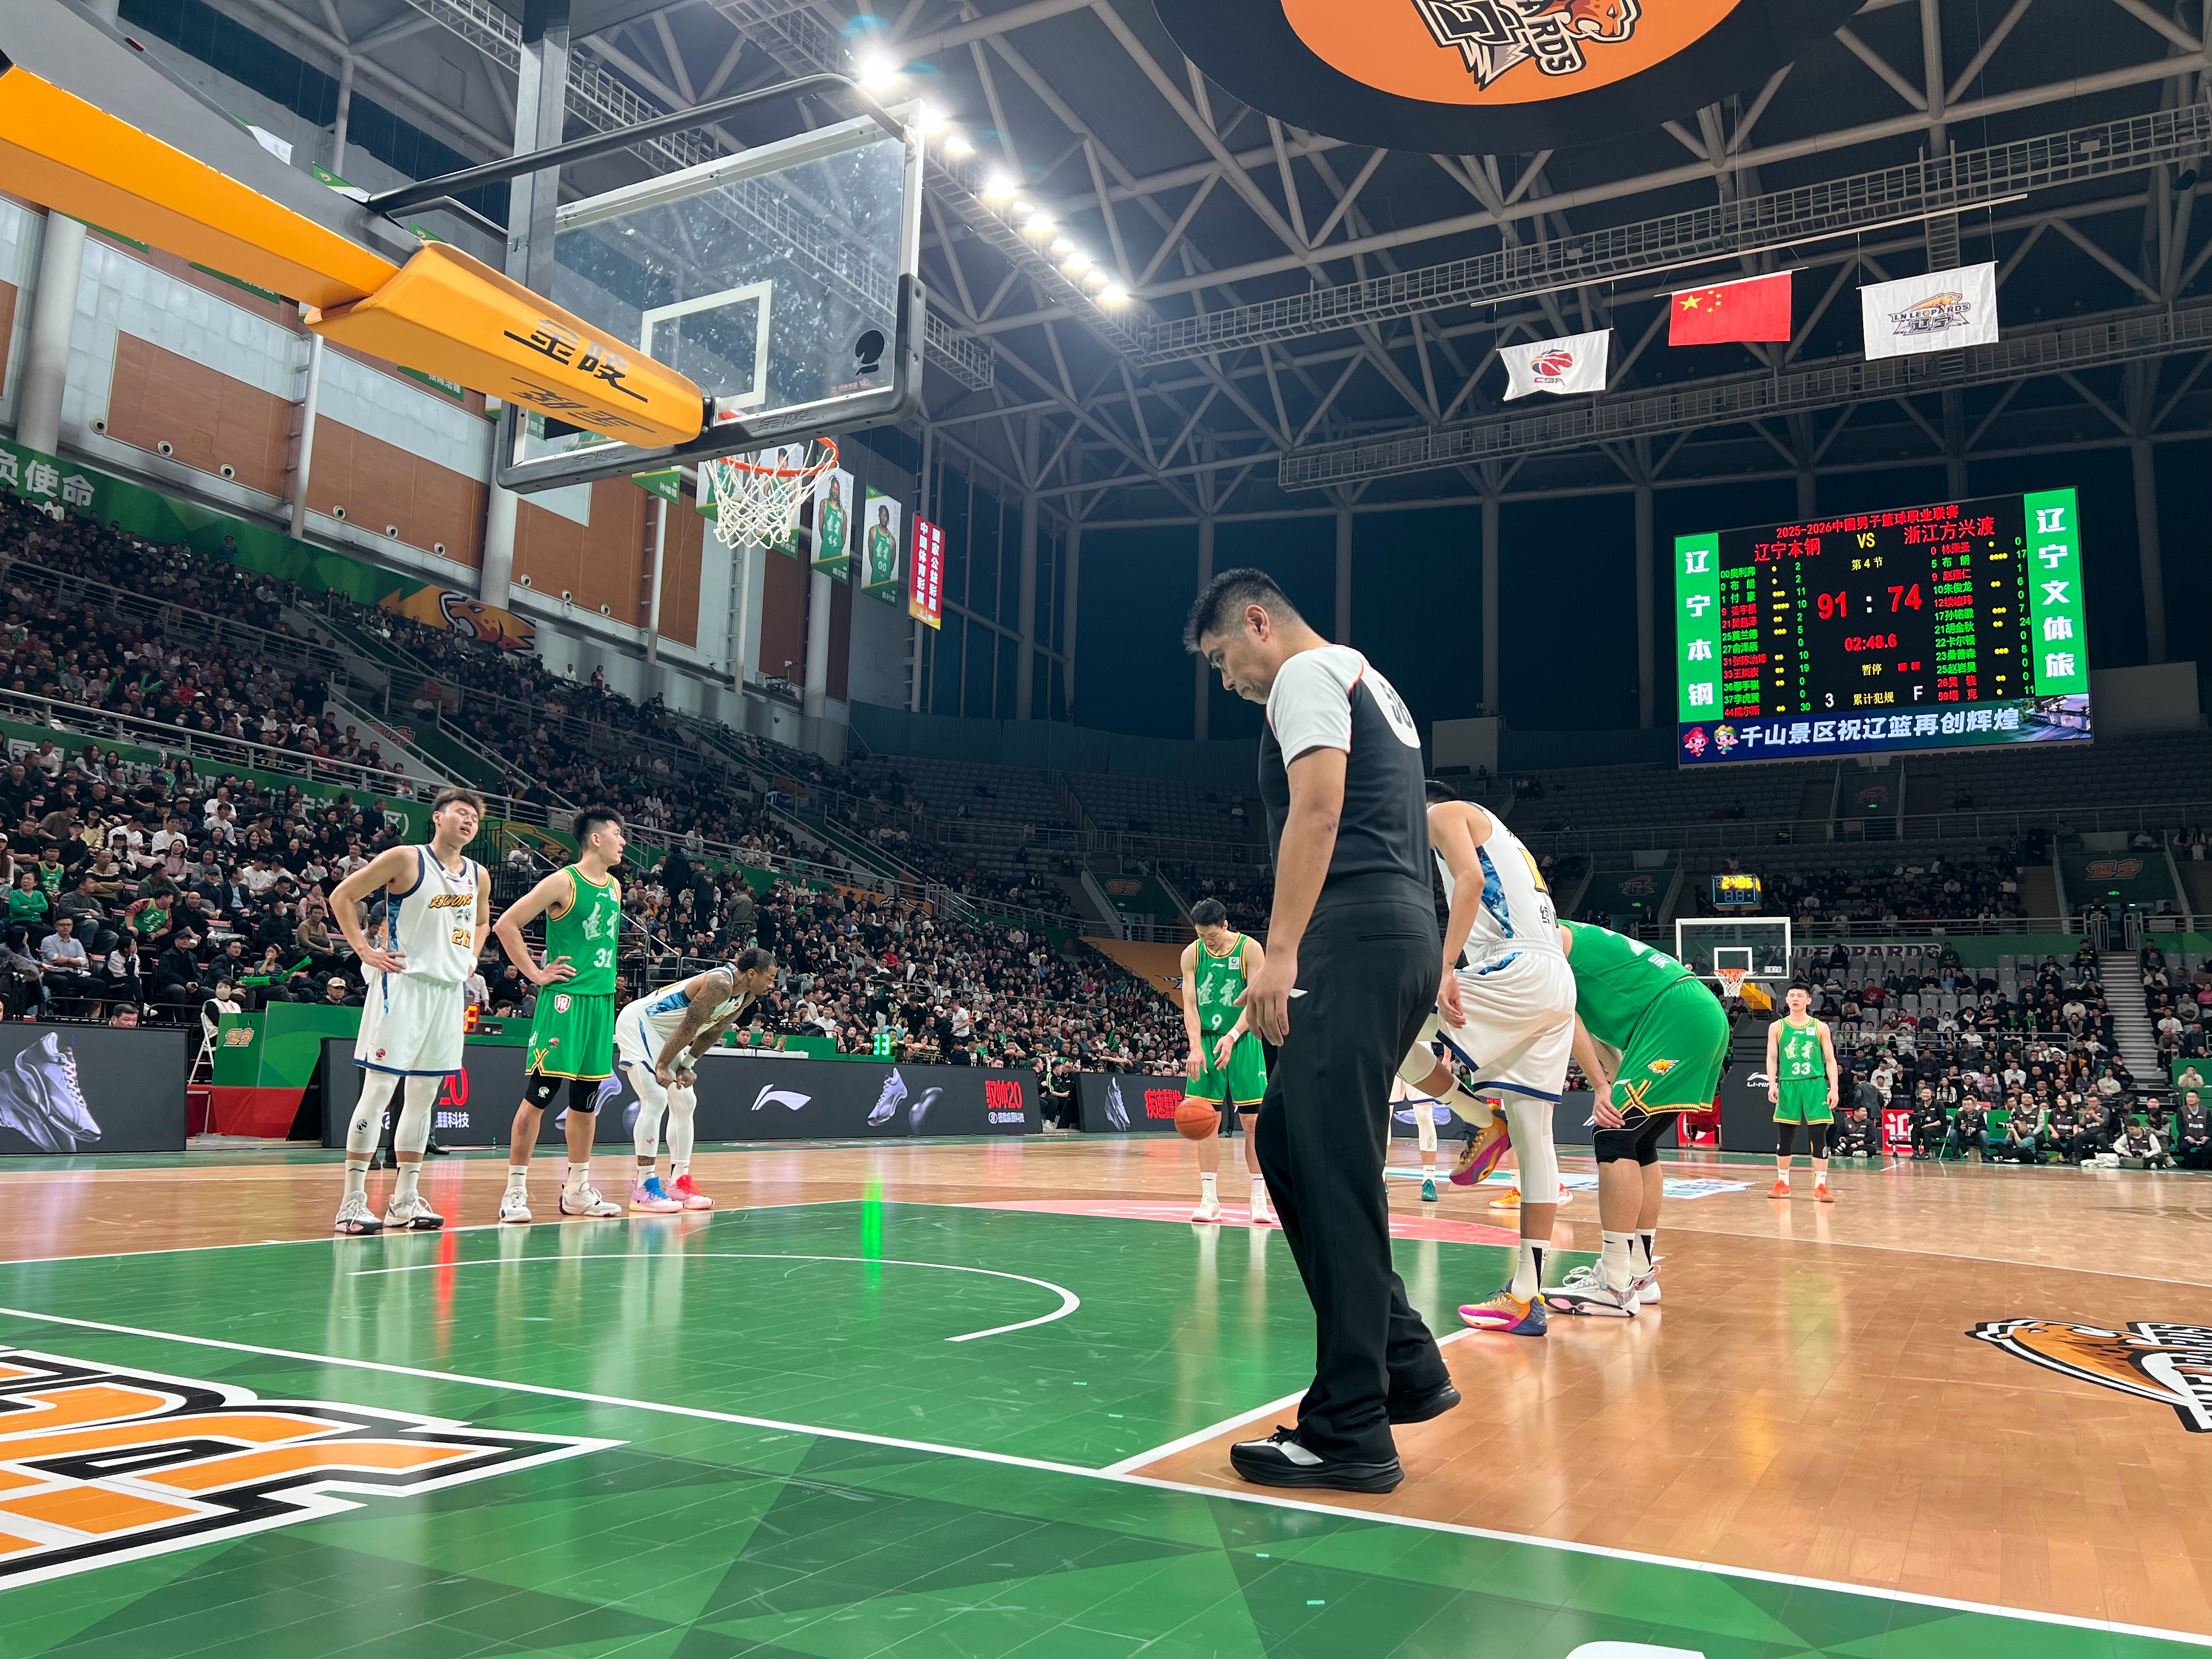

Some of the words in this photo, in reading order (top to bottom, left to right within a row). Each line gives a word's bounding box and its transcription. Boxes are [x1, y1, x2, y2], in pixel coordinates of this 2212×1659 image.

[504, 319, 648, 403] 金陵
[1534, 377, 1566, 386] CBA
[1776, 505, 1959, 539] 2025-2026中国男子篮球职业联赛
[1754, 538, 1821, 562] 辽宁本钢
[1857, 532, 1876, 549] VS
[1904, 516, 1995, 545] 浙江方兴渡
[1931, 546, 1937, 555] 0
[2015, 537, 2021, 545] 0
[916, 521, 928, 606] 中国体育彩票
[1931, 559, 1937, 568] 5
[2017, 549, 2027, 558] 17
[928, 527, 941, 612] 国家公益彩票
[1796, 562, 1801, 571] 2
[1932, 572, 1938, 582] 9
[2017, 564, 2022, 572] 1
[1720, 583, 1726, 591] 0
[1796, 575, 1801, 583] 2
[2017, 578, 2023, 586] 6
[1797, 588, 1805, 596] 11
[2018, 591, 2024, 599] 0
[2036, 507, 2075, 677] 辽宁文体旅
[1797, 600, 1807, 608] 10
[1817, 591, 1847, 619] 91
[1888, 584, 1922, 612] 74
[2019, 604, 2024, 612] 7
[1797, 613, 1803, 622] 2
[2019, 617, 2030, 626] 24
[1685, 550, 1714, 706] 辽宁本钢
[1798, 625, 1803, 634] 5
[2020, 631, 2027, 640] 0
[1798, 639, 1804, 647] 0
[1844, 633, 1897, 652] 02:48.6
[2021, 645, 2028, 653] 8
[1799, 651, 1809, 659] 10
[1800, 664, 1809, 673] 19
[2022, 658, 2028, 667] 0
[1861, 663, 1882, 676] 暂停
[2023, 672, 2029, 680] 0
[1800, 677, 1805, 685] 0
[1800, 690, 1805, 698] 0
[1914, 686, 1923, 701] F
[2024, 686, 2034, 694] 11
[1825, 693, 1835, 708] 3
[1853, 691, 1894, 706] 累计犯规
[1801, 703, 1810, 712] 30
[1740, 707, 2019, 748] 千山景区祝辽篮再创辉煌
[452, 927, 471, 949] 26
[594, 947, 613, 968] 31
[1211, 1013, 1223, 1031] 9
[873, 1033, 891, 1056] 33
[1791, 1062, 1811, 1075] 33
